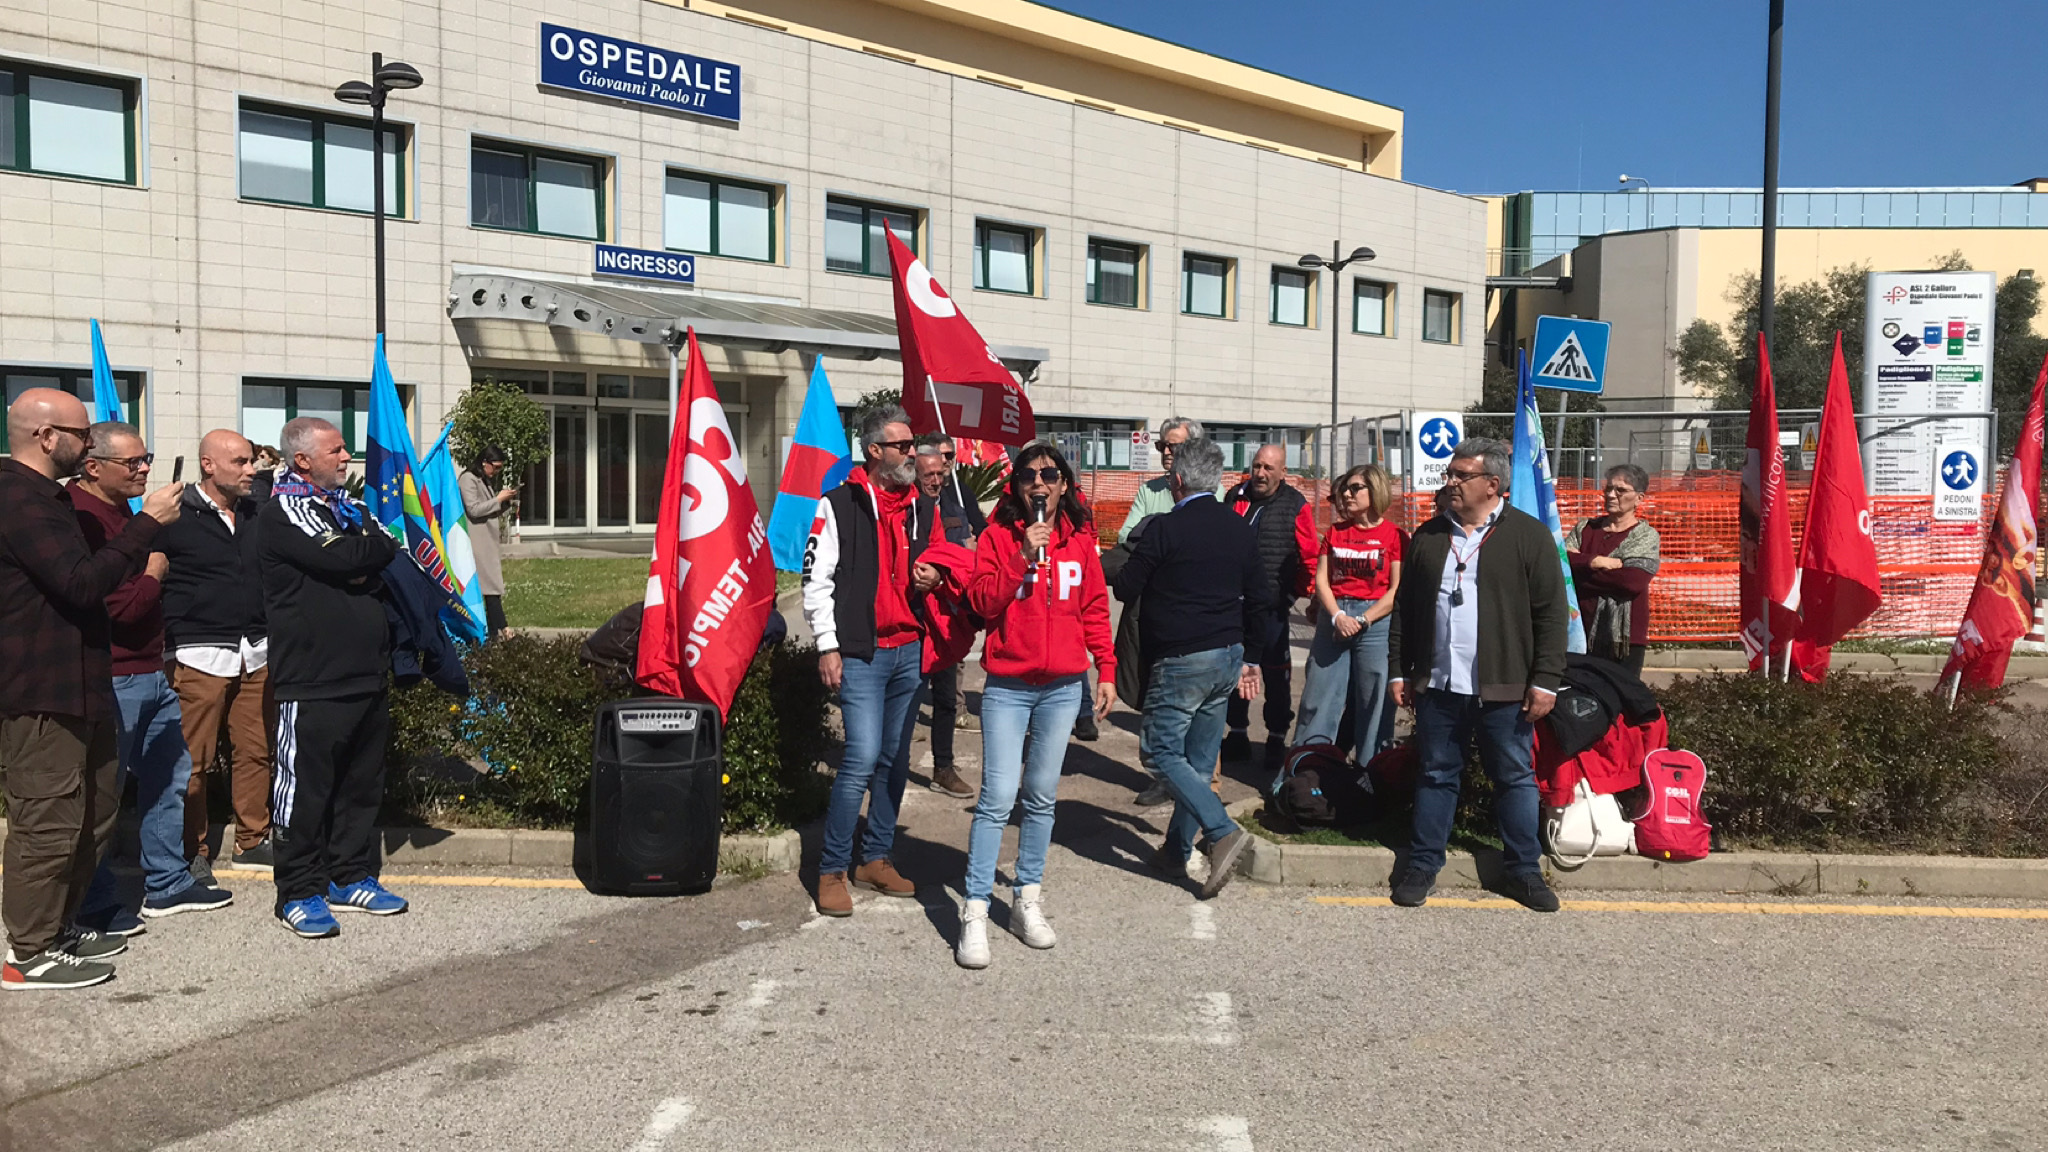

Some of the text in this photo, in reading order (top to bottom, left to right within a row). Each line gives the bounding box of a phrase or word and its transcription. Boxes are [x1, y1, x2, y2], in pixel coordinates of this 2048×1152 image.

[550, 32, 733, 95] OSPEDALE
[578, 69, 706, 108] Giovanni Paolo II
[598, 250, 692, 277] INGRESSO
[1930, 284, 1957, 292] Gallura
[1424, 464, 1449, 472] PEDO
[1943, 495, 1974, 503] PEDONI
[1944, 507, 1978, 516] SINISTRA
[415, 537, 455, 594] UIL
